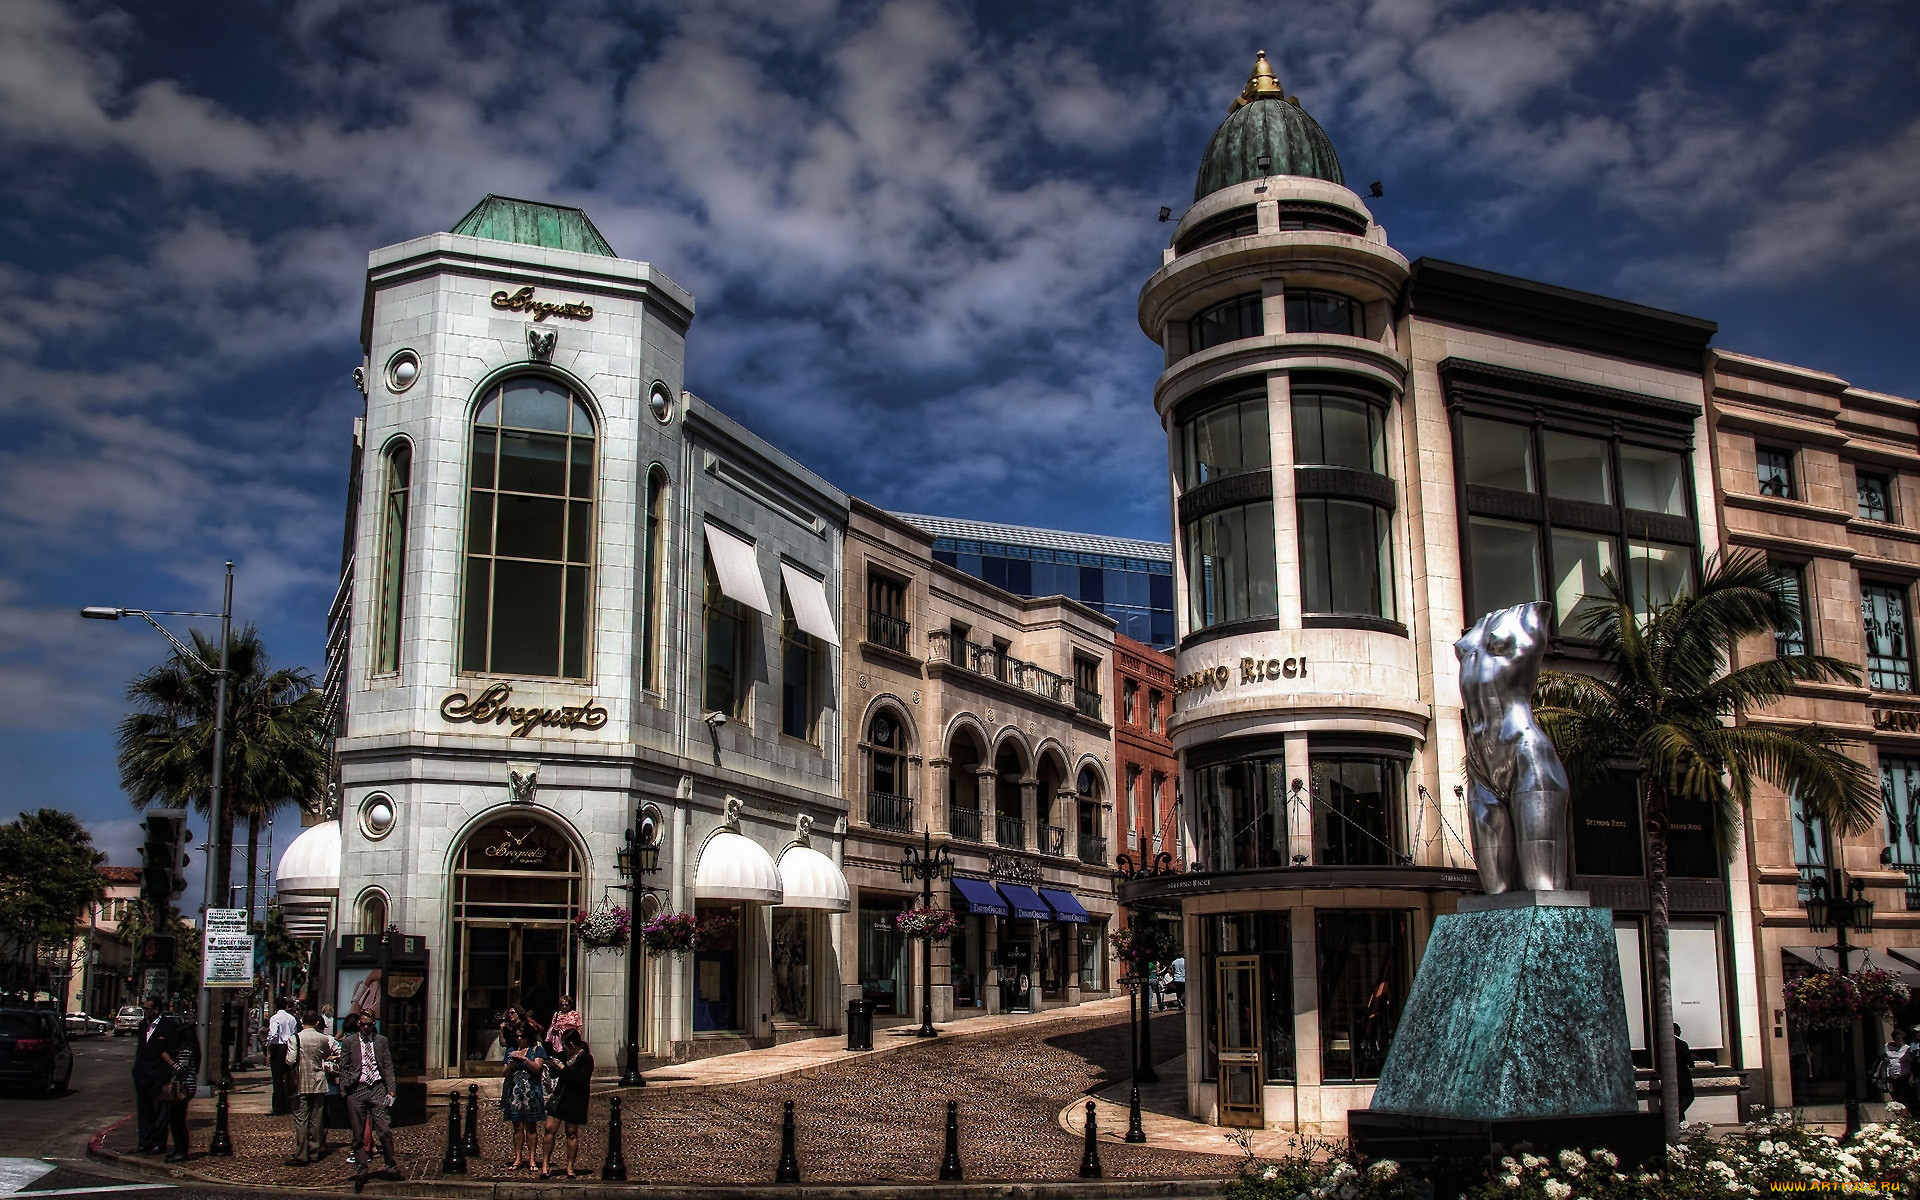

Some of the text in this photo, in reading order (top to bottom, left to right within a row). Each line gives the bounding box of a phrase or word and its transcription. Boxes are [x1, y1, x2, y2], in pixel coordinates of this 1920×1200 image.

[491, 286, 594, 322] Breguet
[440, 682, 608, 737] Breguet
[484, 841, 547, 864] Breguet
